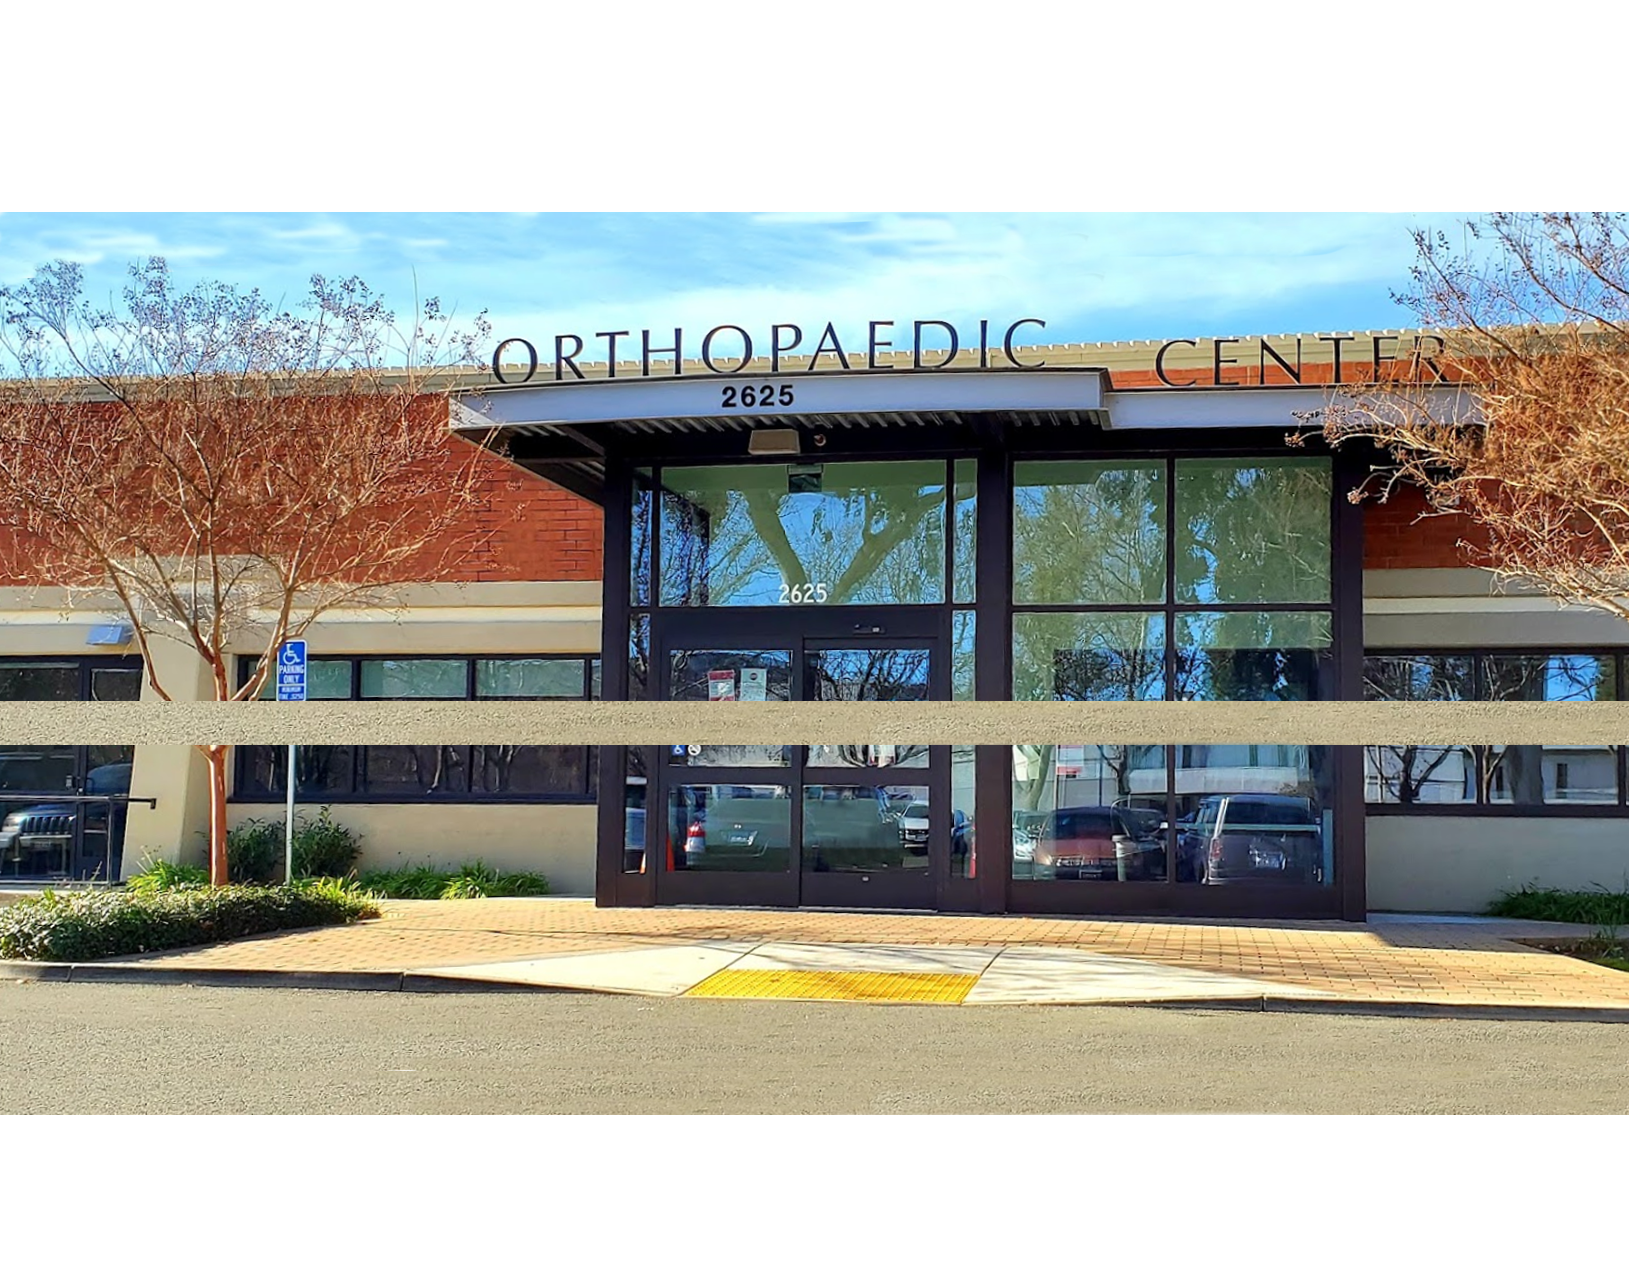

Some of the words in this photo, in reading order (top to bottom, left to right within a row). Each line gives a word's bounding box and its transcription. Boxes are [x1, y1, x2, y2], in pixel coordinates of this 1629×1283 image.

[493, 319, 1046, 384] ORTHOPAEDIC
[722, 385, 794, 407] 2625
[779, 583, 827, 603] 2625
